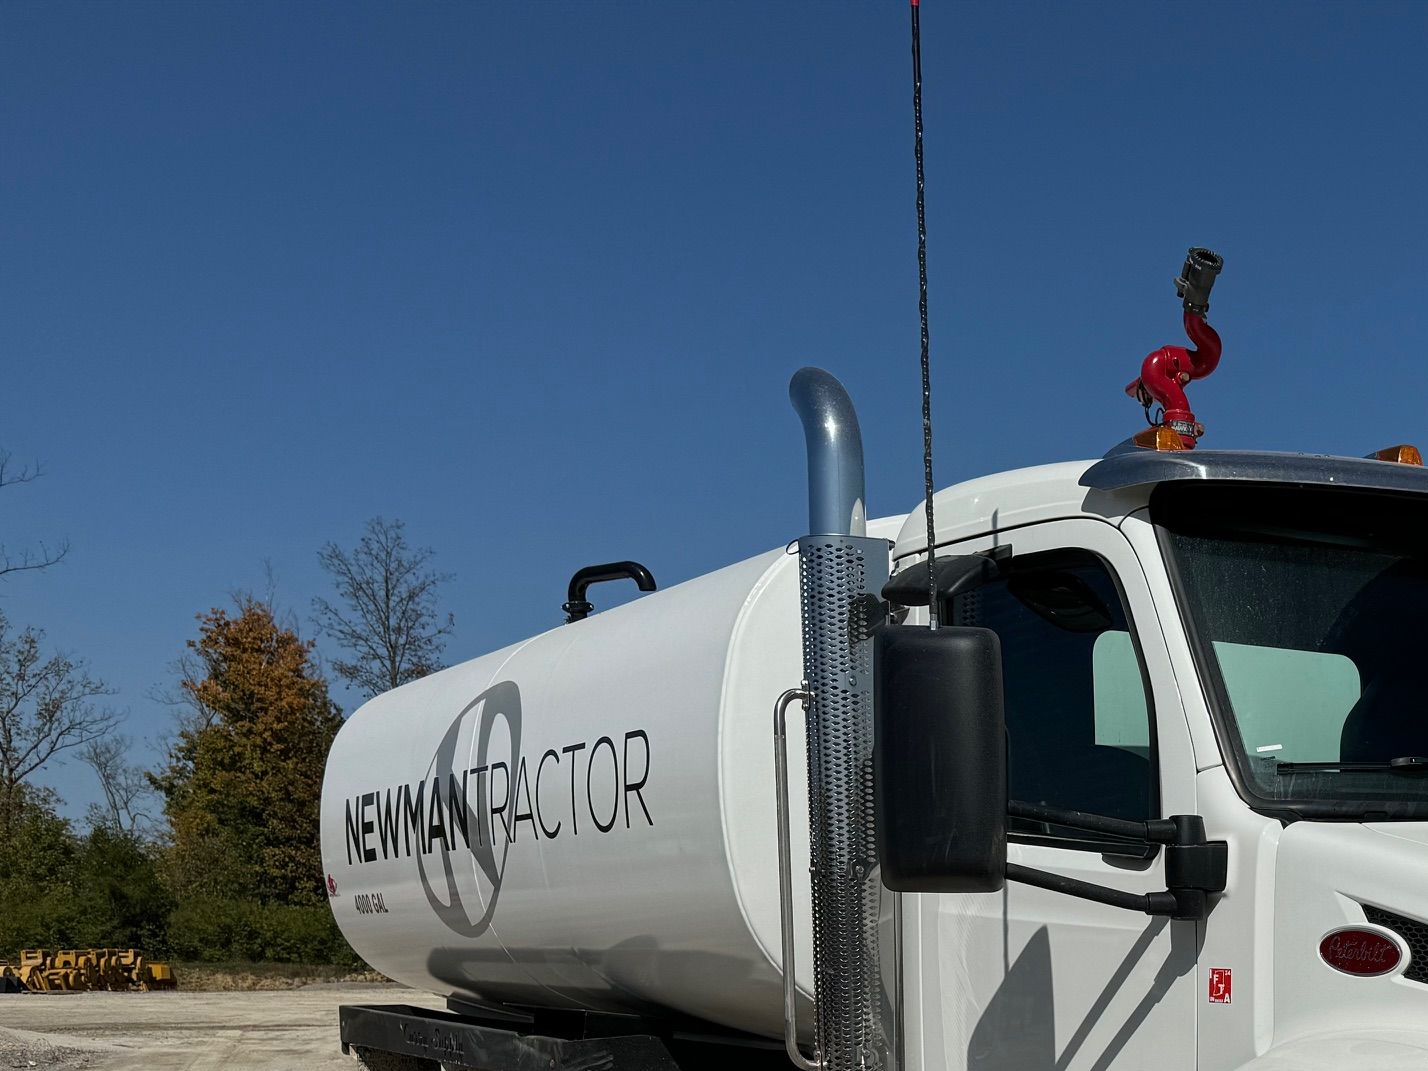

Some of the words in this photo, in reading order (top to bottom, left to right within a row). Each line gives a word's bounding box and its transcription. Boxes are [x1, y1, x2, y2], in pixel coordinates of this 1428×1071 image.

[354, 893, 373, 915] 4000
[371, 892, 389, 914] GAL
[1328, 935, 1392, 963] Peterbilt
